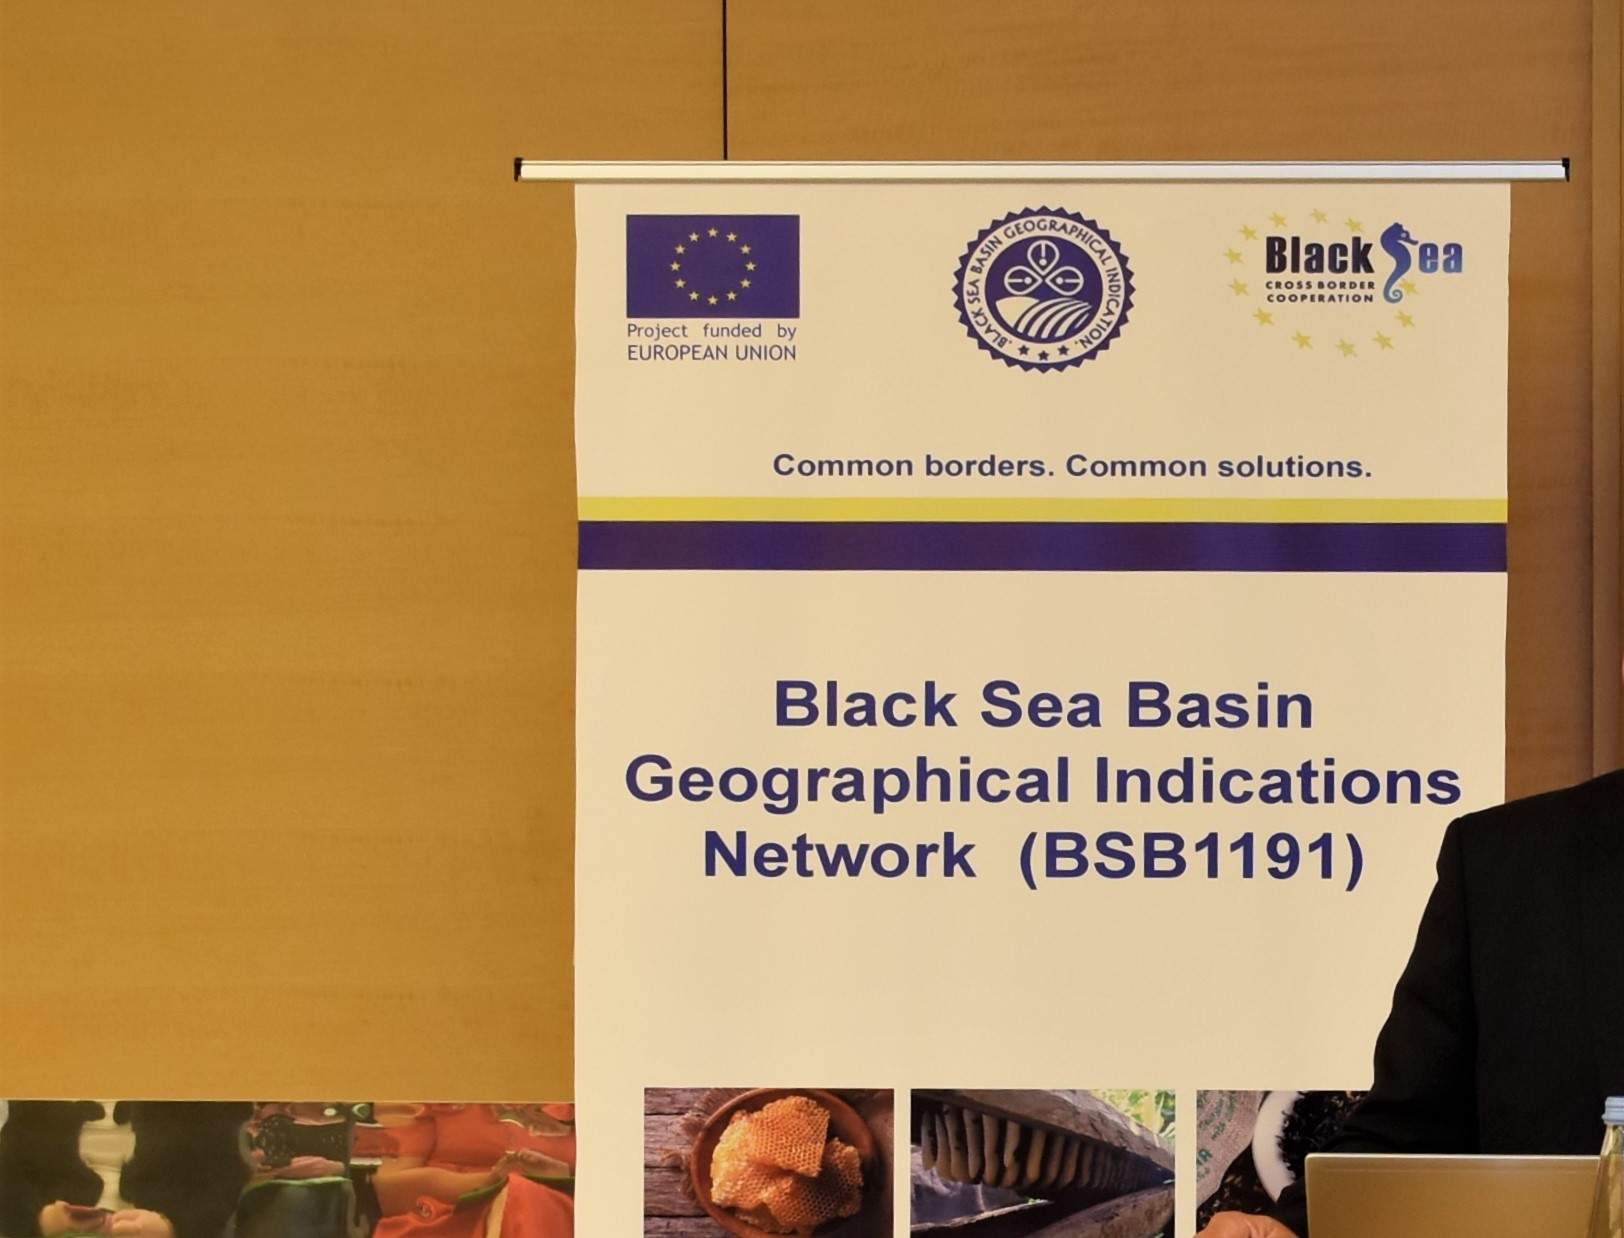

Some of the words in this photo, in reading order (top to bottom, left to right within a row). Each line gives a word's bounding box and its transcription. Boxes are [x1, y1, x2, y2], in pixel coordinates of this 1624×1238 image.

[969, 235, 1004, 274] BASIN
[1003, 218, 1113, 267] GEOGRAPHICAL
[1265, 235, 1375, 275] Black
[966, 279, 981, 304] SEA
[1265, 280, 1313, 290] CROSS
[1317, 280, 1375, 290] BORDER
[1266, 293, 1374, 303] COOPERATION
[627, 323, 689, 342] Project
[702, 322, 762, 338] funded
[777, 323, 797, 342] by
[627, 344, 728, 361] EUROPEAN
[735, 344, 796, 361] UNION
[773, 453, 913, 477] Common
[925, 453, 1055, 477] borders.
[1066, 453, 1207, 478] Common
[1217, 454, 1372, 478] solutions.
[775, 680, 958, 728] Black
[980, 679, 1102, 729] Sea
[1128, 680, 1312, 729] Basin
[625, 754, 1069, 815] Geographical
[1096, 756, 1463, 805] Indications
[704, 830, 977, 879] Network
[1019, 830, 1364, 892] (BSB1191)
